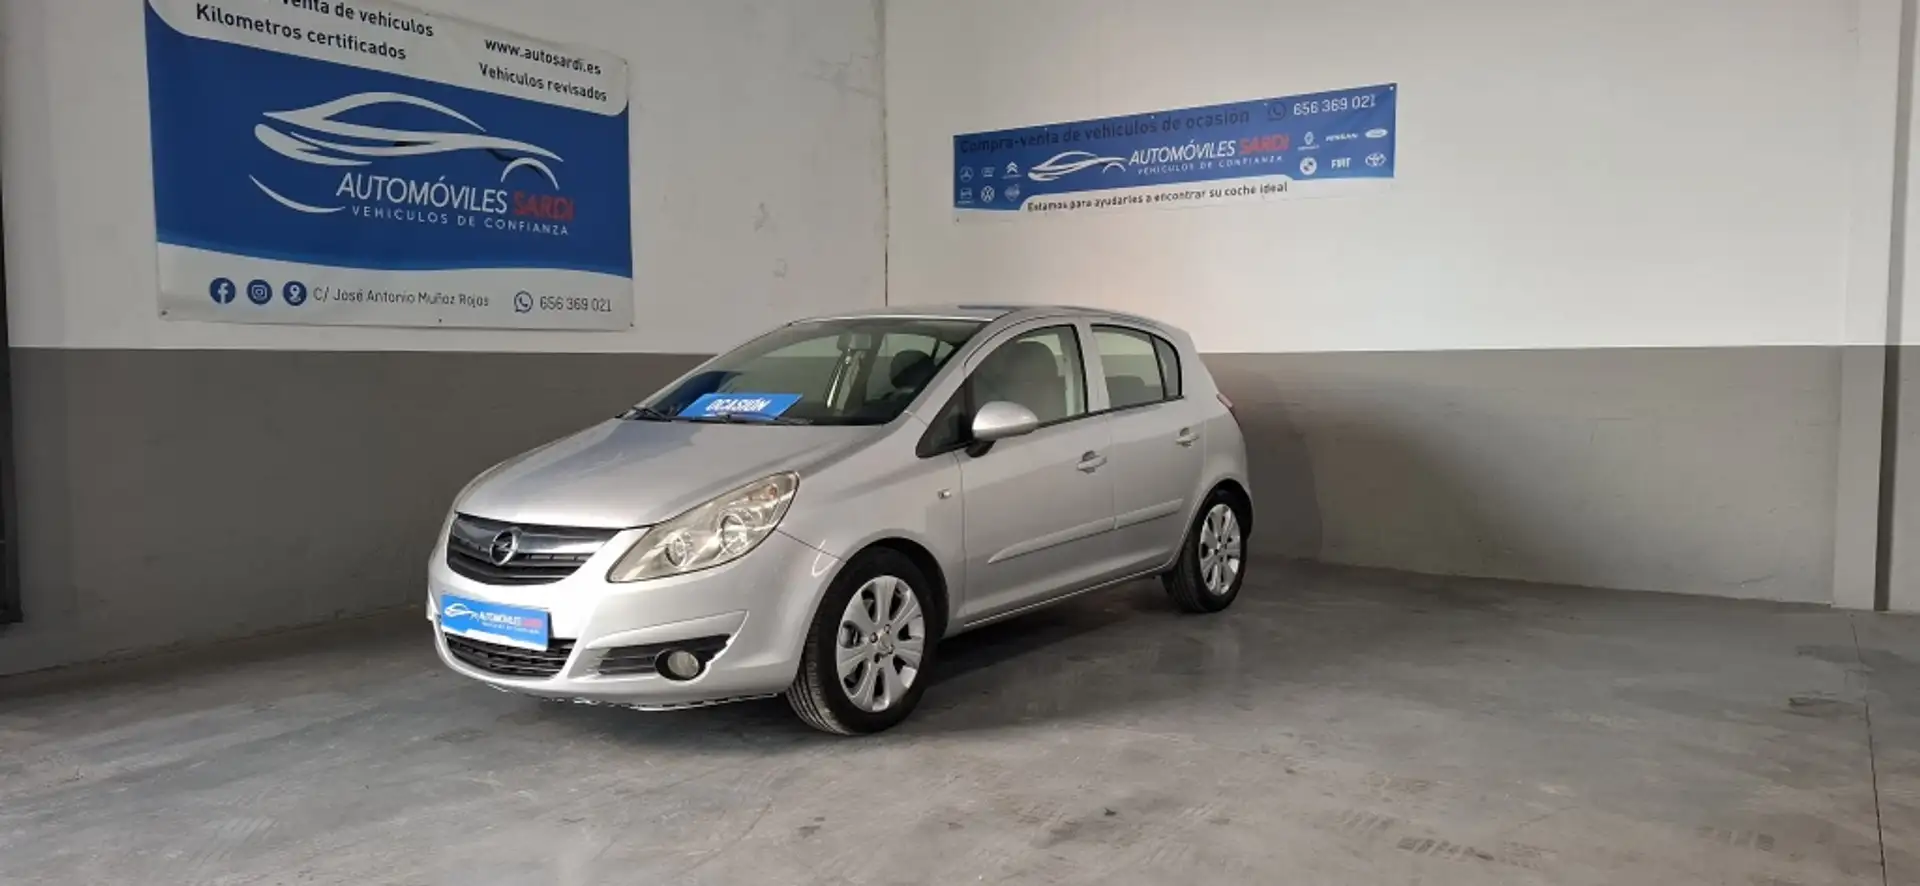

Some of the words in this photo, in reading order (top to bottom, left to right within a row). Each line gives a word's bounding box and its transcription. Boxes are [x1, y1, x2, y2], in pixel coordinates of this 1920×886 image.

[335, 2, 355, 20] de
[196, 2, 302, 40] Kilometros
[306, 27, 407, 60] certificados
[484, 38, 602, 75] www.autosardi.es
[547, 80, 608, 102] revisados
[1293, 98, 1318, 116] 656
[1321, 96, 1348, 114] 369
[1351, 93, 1376, 109] 021
[960, 130, 1060, 154] Compra-venta
[1062, 129, 1082, 144] de
[1162, 115, 1182, 132] de
[1128, 138, 1237, 166] AUTOMÓVILES
[1240, 133, 1290, 155] SARDI
[1200, 161, 1213, 170] DE
[1218, 155, 1283, 168] CONFIANZA
[1331, 156, 1351, 169] FIAT
[335, 172, 508, 215] AUTOMÓVILES
[513, 190, 575, 222] SARDI
[1027, 199, 1068, 213] Estamos
[1070, 199, 1092, 211] para
[1095, 194, 1143, 209] ayudarles
[1145, 195, 1152, 204] a
[1154, 188, 1206, 202] encontrar
[1209, 188, 1222, 198] su
[1225, 185, 1256, 196] coche
[1260, 180, 1288, 194] ideal
[456, 215, 476, 228] DE
[484, 217, 570, 237] CONFIANZA
[312, 287, 328, 302] C/
[332, 286, 363, 303] José
[365, 289, 415, 304] Antonio
[458, 292, 490, 308] Rojas
[539, 295, 564, 311] 656
[566, 296, 589, 312] 369
[591, 297, 612, 313] 021
